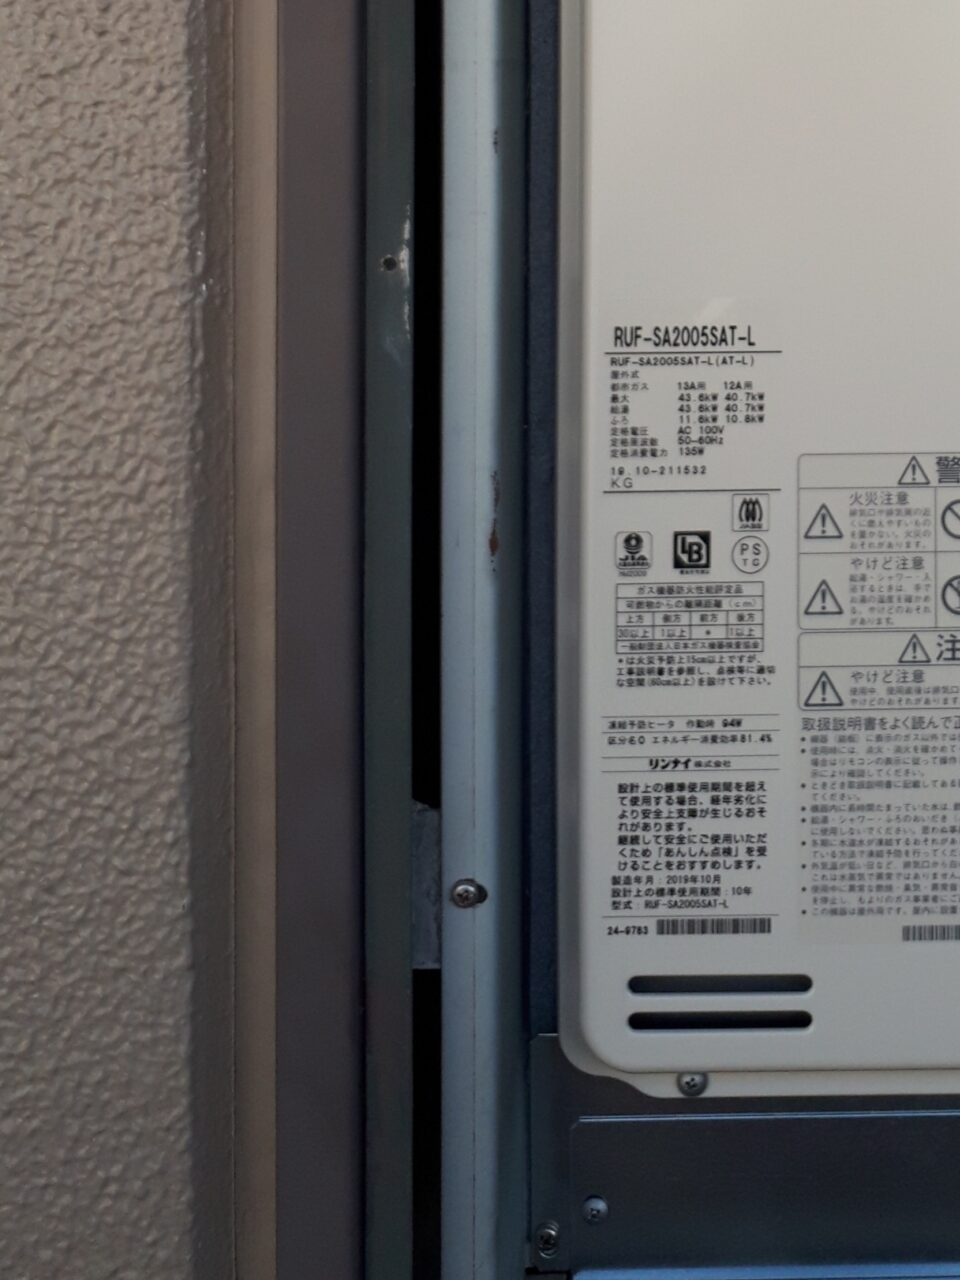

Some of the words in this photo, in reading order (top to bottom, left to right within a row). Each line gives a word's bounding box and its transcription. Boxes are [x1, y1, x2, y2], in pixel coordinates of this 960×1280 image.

[614, 326, 756, 347] RUF-SA2005SAT-L
[849, 491, 909, 506] 火災注意
[850, 556, 925, 570] やけど注意
[850, 669, 925, 683] やけど注意
